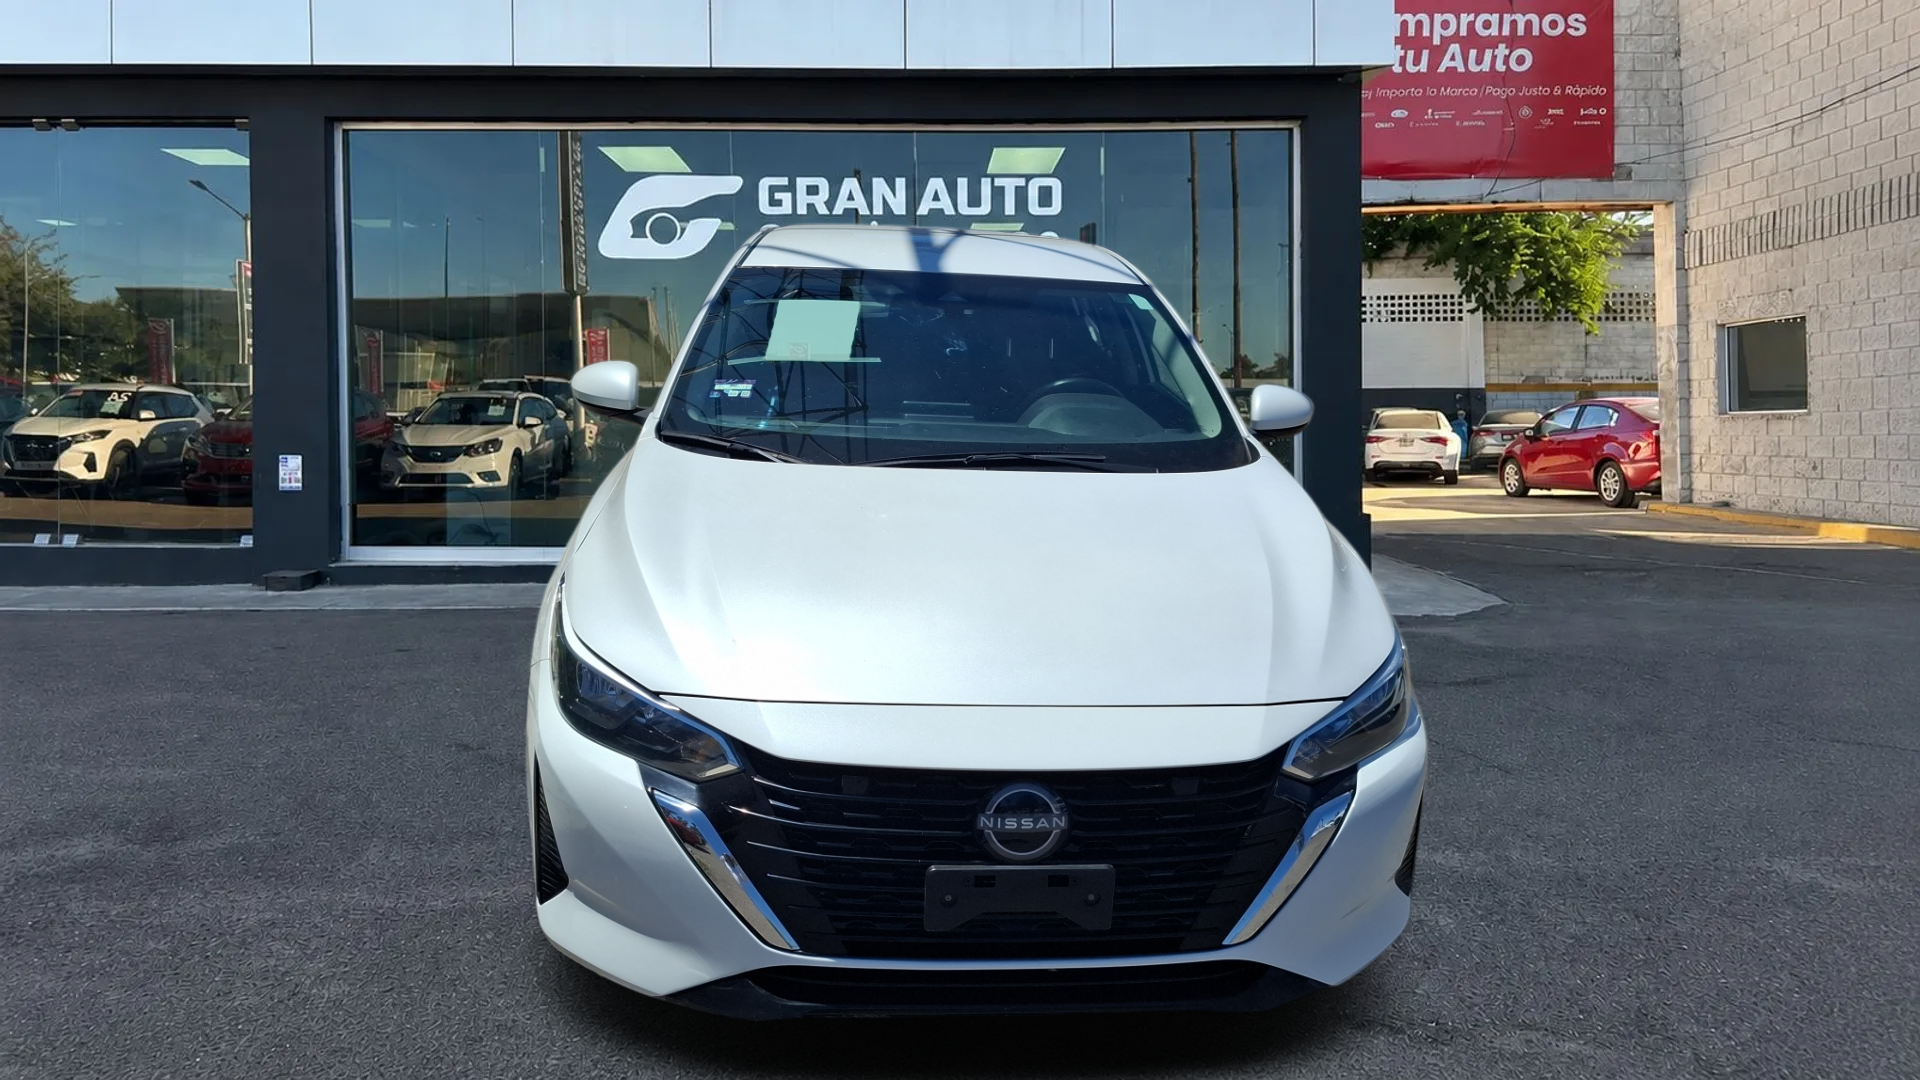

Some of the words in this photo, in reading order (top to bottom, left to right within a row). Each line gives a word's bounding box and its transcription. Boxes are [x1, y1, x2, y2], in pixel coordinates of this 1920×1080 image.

[1392, 44, 1430, 73] tu
[1437, 43, 1533, 73] Auto
[1376, 87, 1423, 99] Importa
[1426, 86, 1437, 96] la
[1440, 87, 1478, 96] Marca
[1519, 86, 1550, 96] Justo
[1553, 85, 1561, 96] &
[1565, 84, 1607, 98] Rápido
[758, 177, 907, 215] GRAN
[917, 177, 1063, 216] AUTO
[980, 816, 1066, 829] NISSAN
